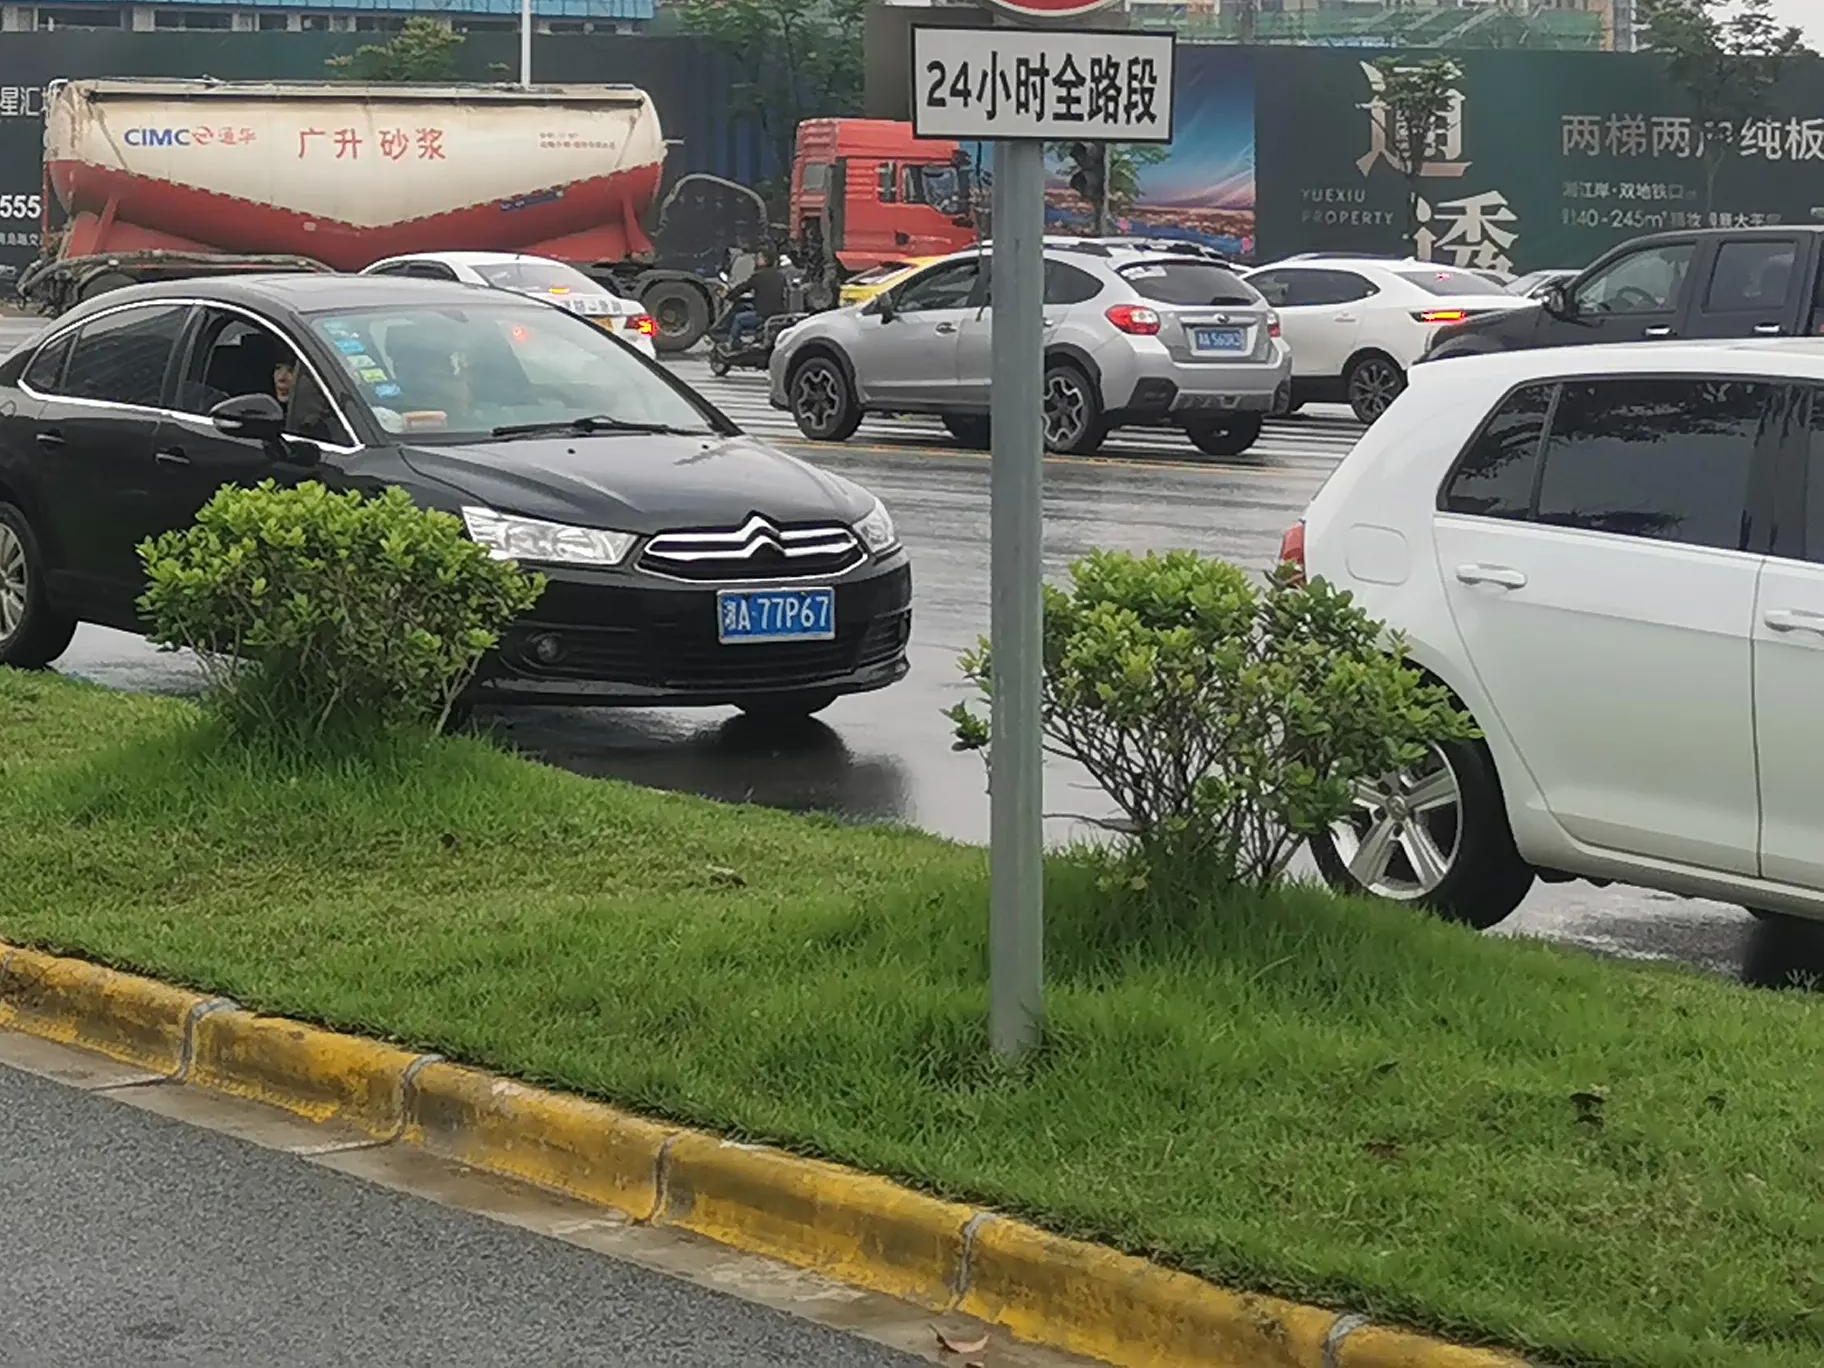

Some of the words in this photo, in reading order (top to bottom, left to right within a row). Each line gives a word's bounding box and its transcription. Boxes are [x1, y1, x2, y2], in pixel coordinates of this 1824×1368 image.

[926, 50, 1158, 125] 24小时全路段
[123, 128, 190, 147] CIMC
[298, 127, 446, 161] 广升砂浆
[1300, 187, 1366, 203] YUEXIU
[1300, 209, 1395, 226] PROPERTY
